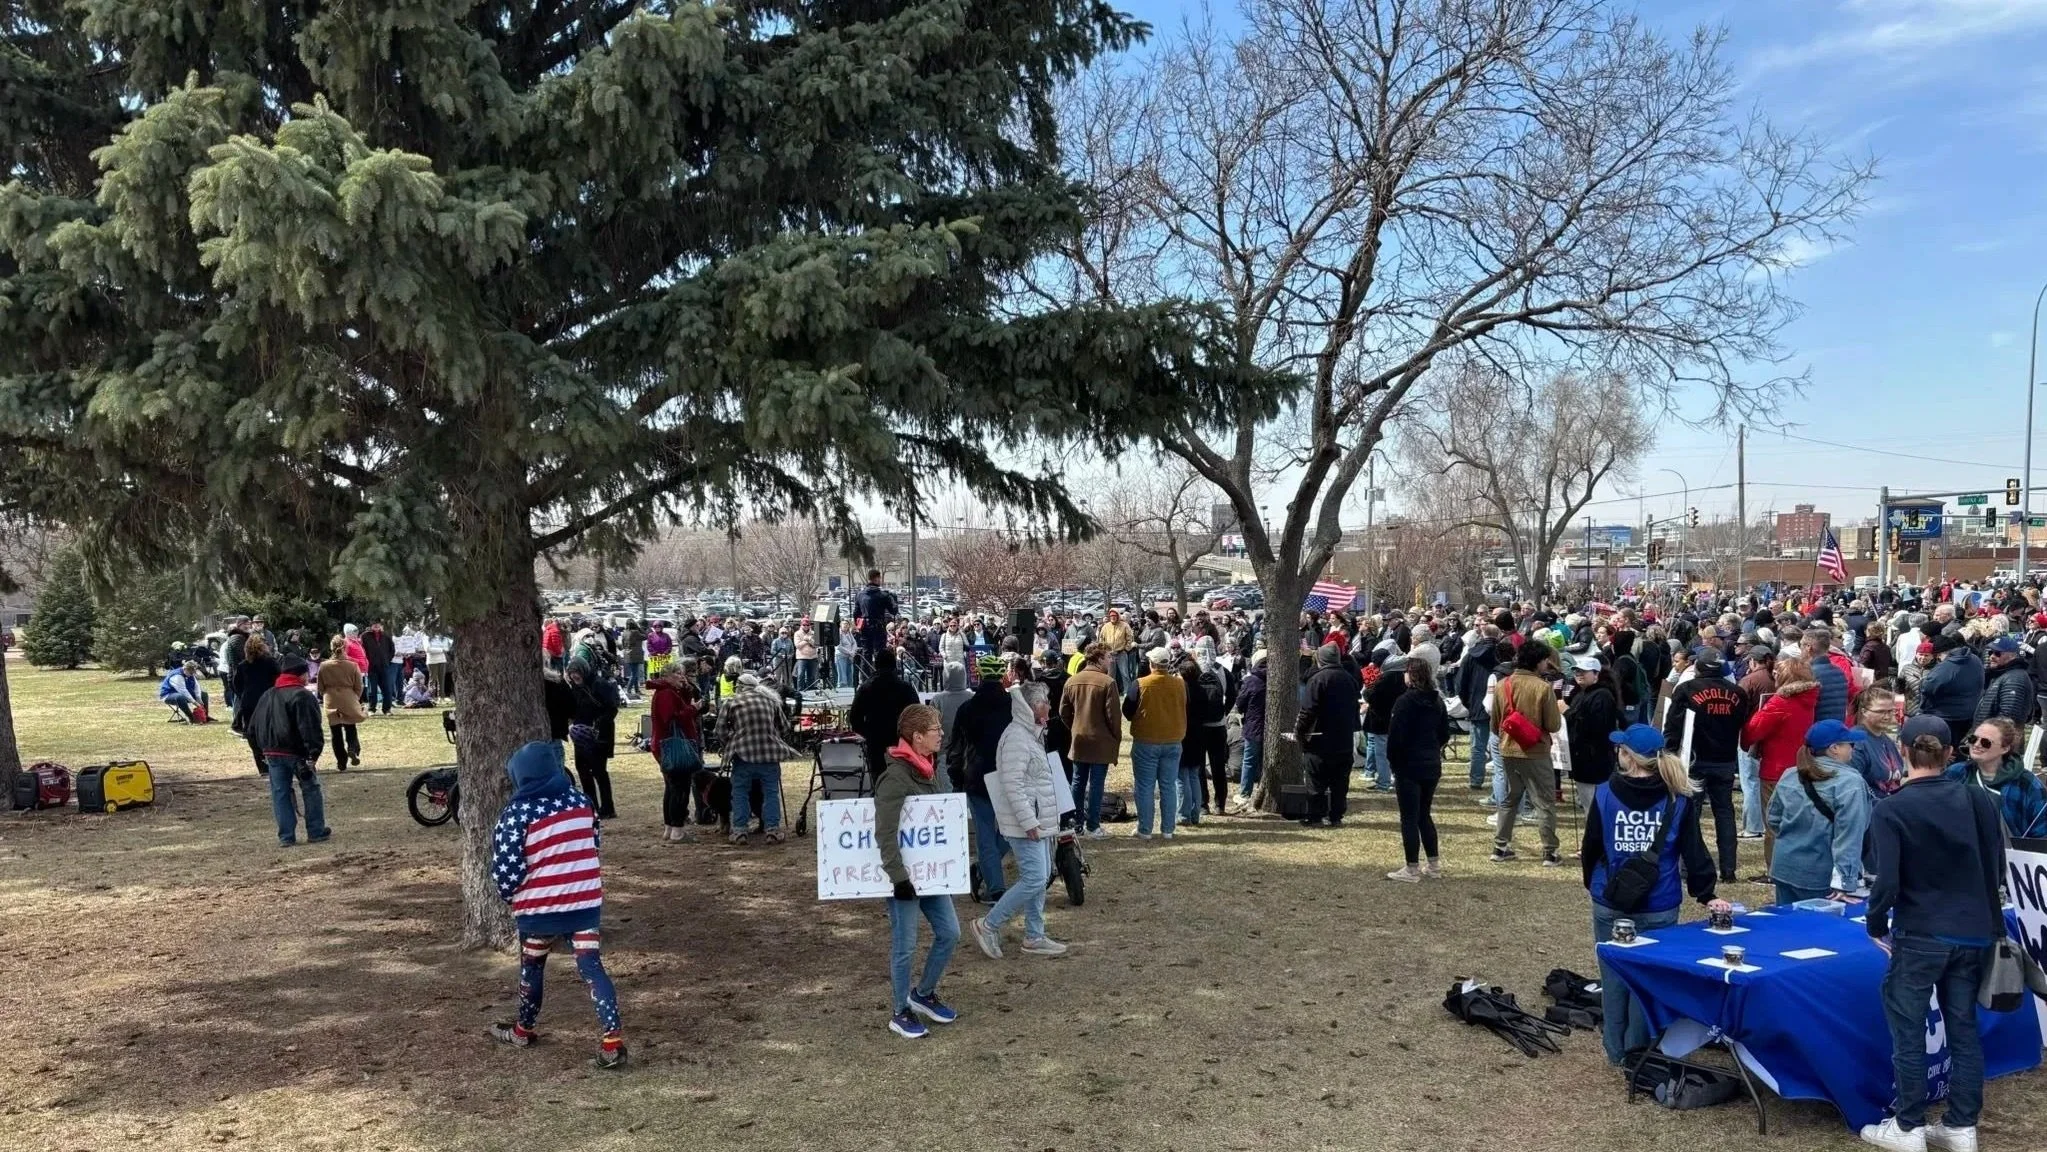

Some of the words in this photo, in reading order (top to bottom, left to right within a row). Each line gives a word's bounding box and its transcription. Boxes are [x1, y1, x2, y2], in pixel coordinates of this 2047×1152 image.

[1707, 703, 1731, 714] PARK
[839, 804, 945, 826] ALXA:
[839, 825, 948, 849] CHNGE
[1614, 825, 1661, 841] LEGA
[1614, 841, 1653, 852] OBSERV
[832, 859, 956, 885] PRESENT
